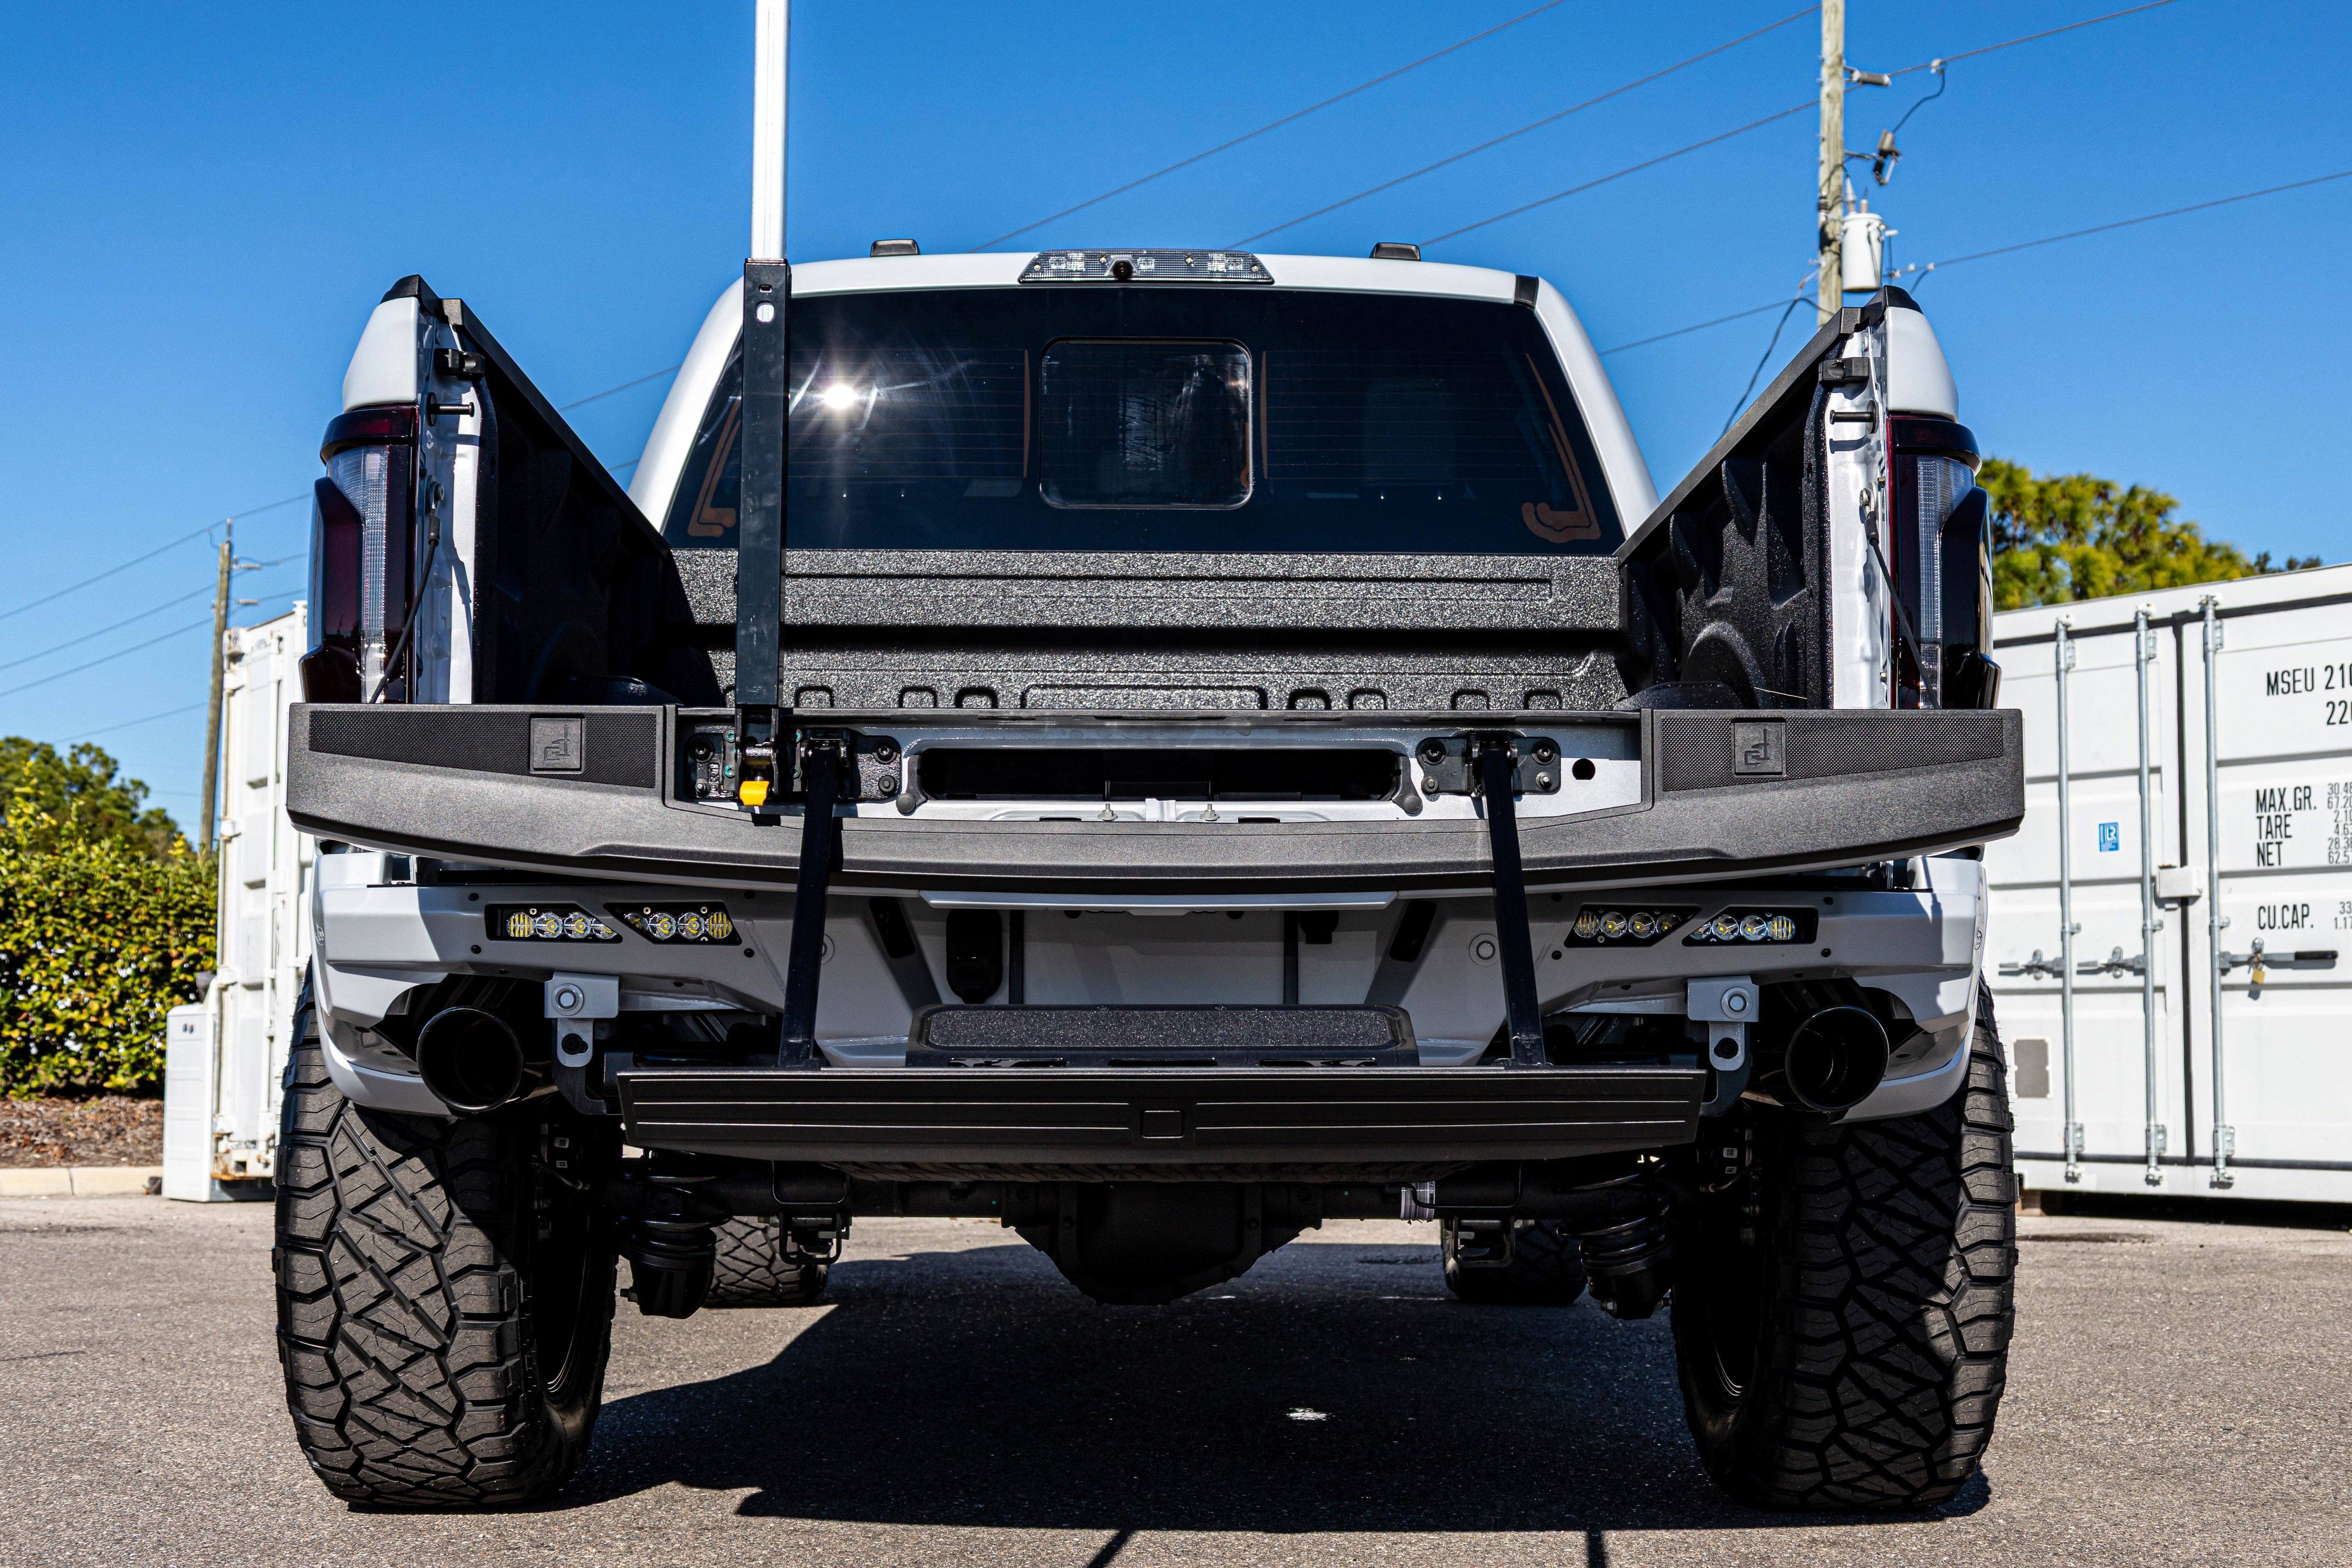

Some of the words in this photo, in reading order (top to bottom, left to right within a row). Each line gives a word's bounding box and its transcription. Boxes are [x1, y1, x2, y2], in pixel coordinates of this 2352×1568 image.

[2267, 667, 2314, 696] MSEU
[2326, 700, 2352, 725] 22
[2256, 786, 2317, 813] MAX.GR.
[2256, 814, 2292, 840] TARE
[2257, 841, 2283, 866] NET
[2258, 904, 2314, 930] CU.CAP.
